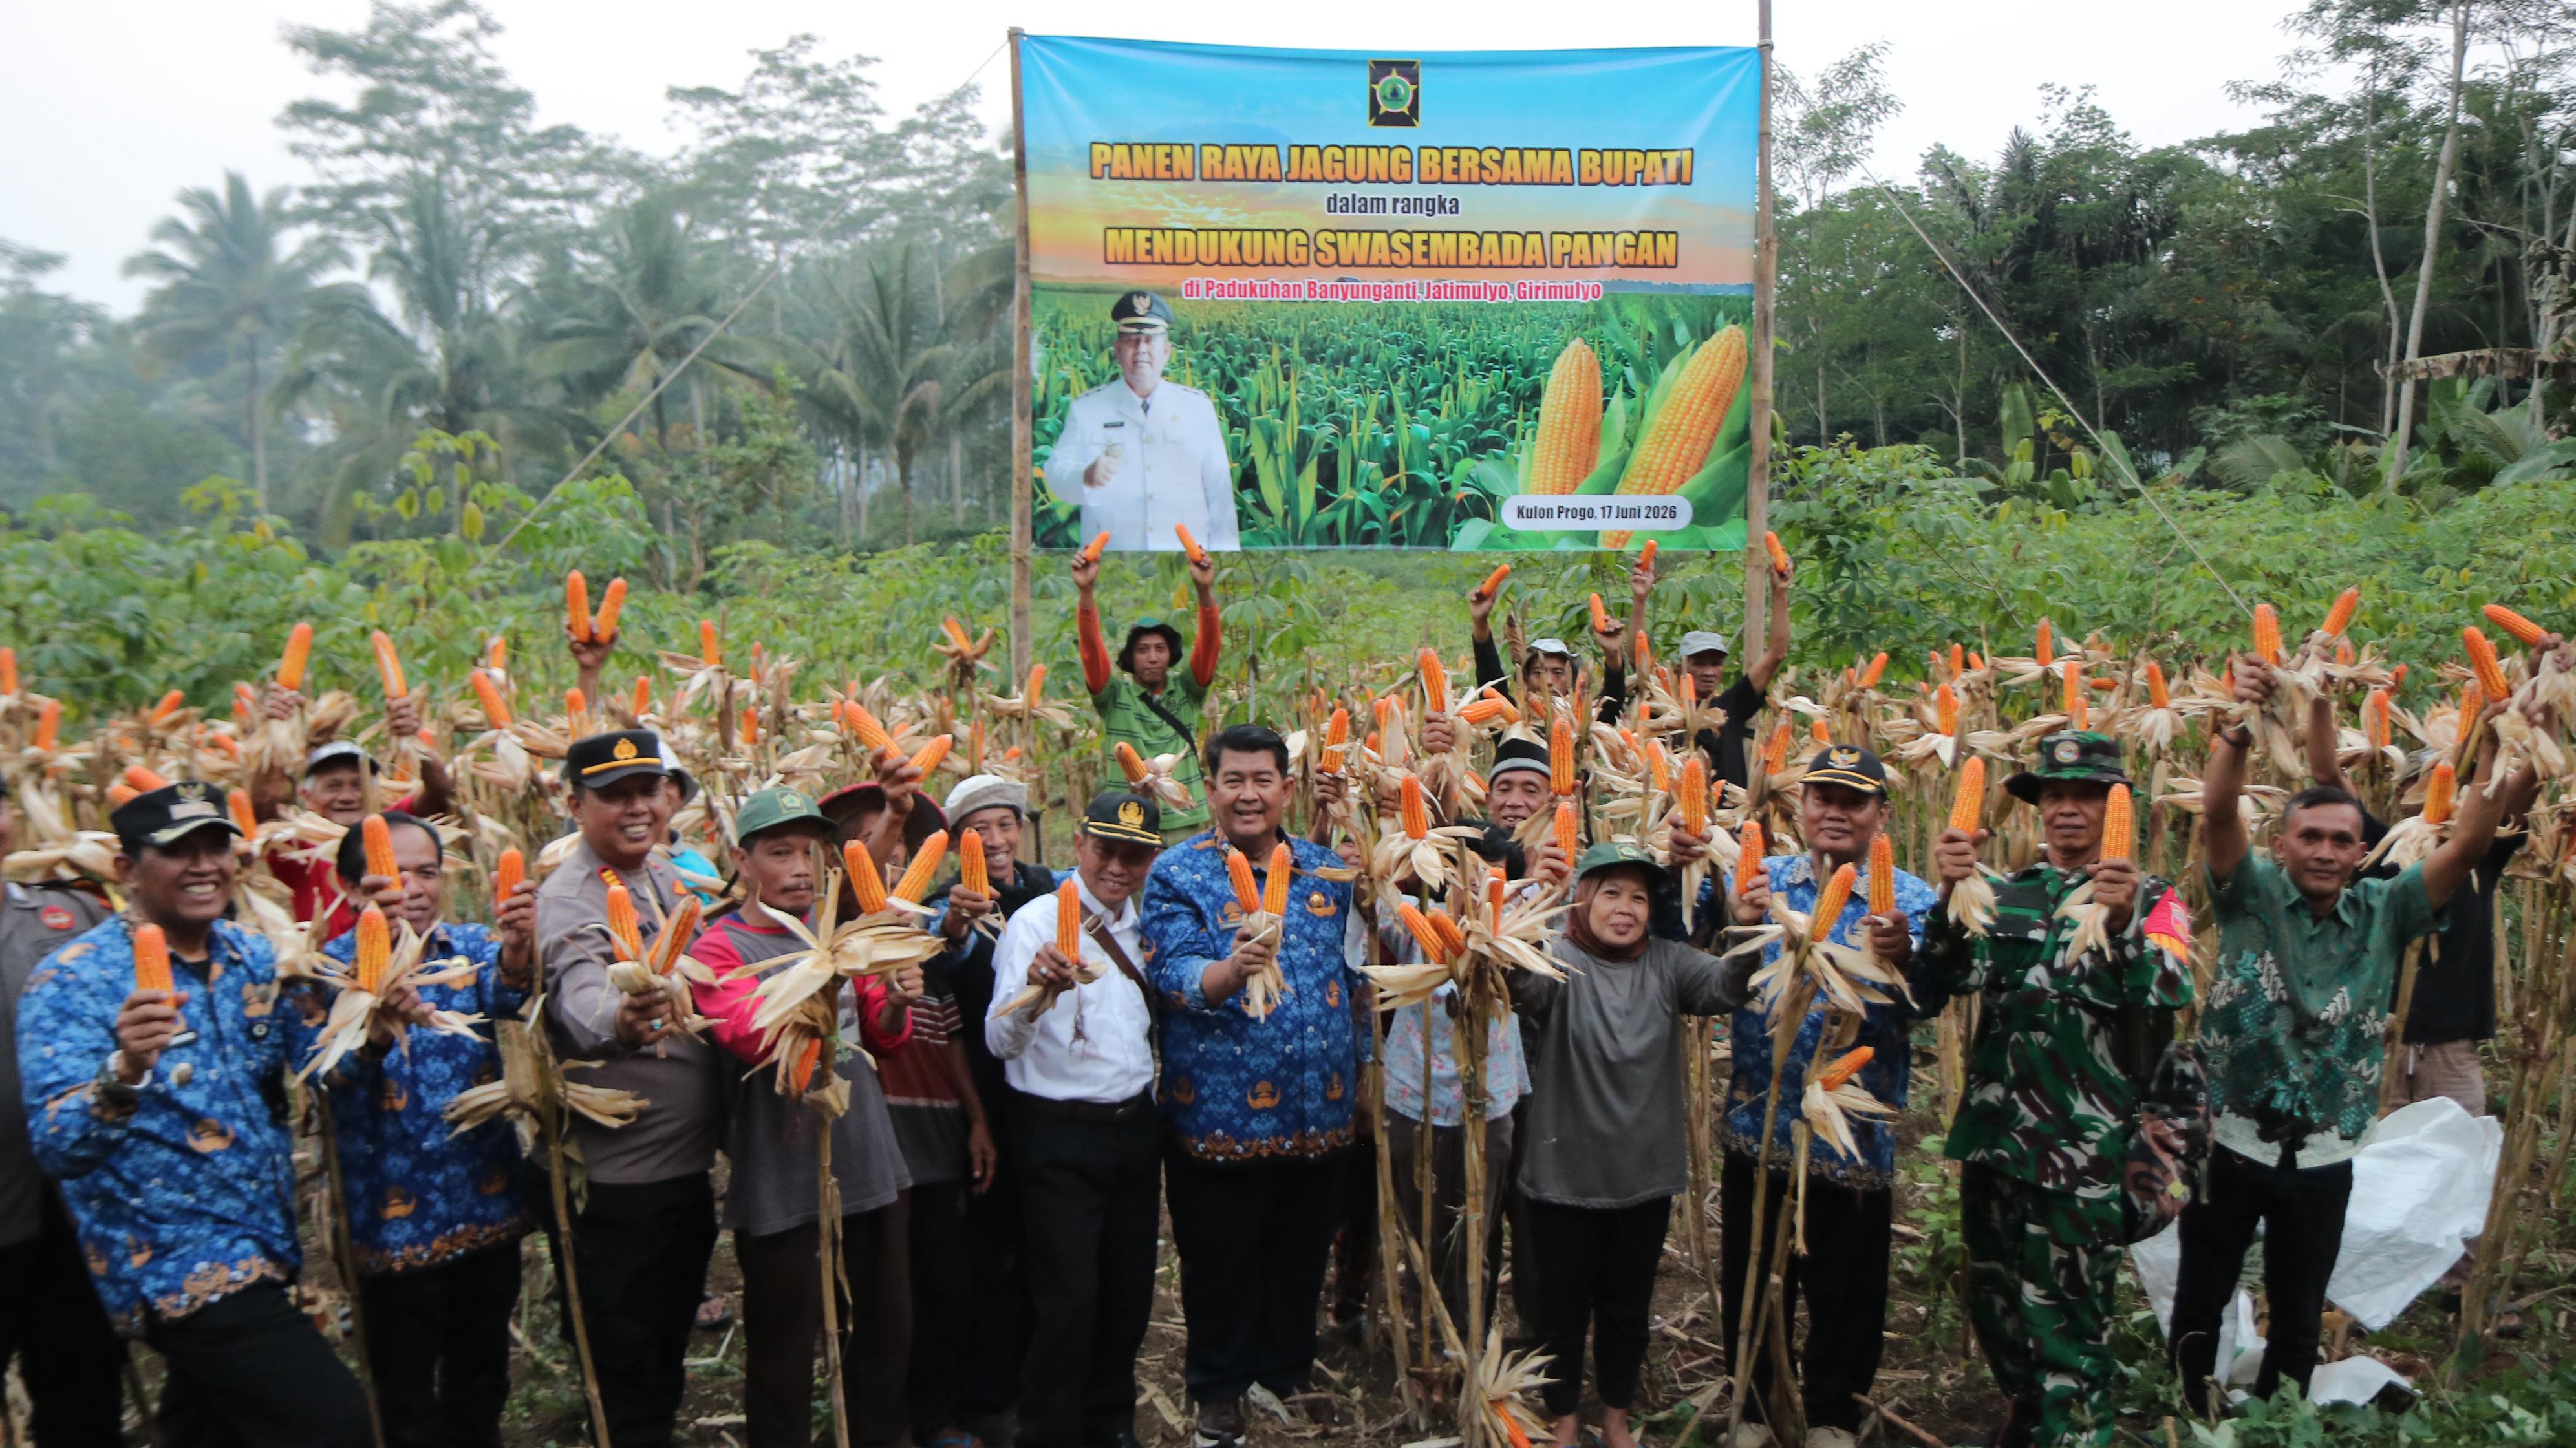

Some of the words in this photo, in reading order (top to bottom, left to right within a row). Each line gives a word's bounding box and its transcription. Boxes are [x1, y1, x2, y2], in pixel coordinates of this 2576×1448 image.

[1090, 142, 1194, 181] PANEN
[1200, 144, 1282, 182] RAYA
[1285, 145, 1413, 183] JAGUNG
[1419, 146, 1574, 185] BERSAMA
[1578, 148, 1693, 186] BUPATI
[1327, 193, 1388, 214] dalam
[1392, 194, 1459, 217] rangka
[1104, 228, 1309, 266] MENDUKUNG
[1315, 229, 1547, 268] SWASEMBADA
[1551, 231, 1678, 268] PANGAN
[1184, 279, 1201, 298] di
[1205, 280, 1302, 299] Padukuhan
[1307, 281, 1422, 301] Banyunganti,
[1424, 281, 1513, 302] Jatimulyo,
[1516, 282, 1602, 301] Girimulyo
[1517, 506, 1553, 519] Kulon
[1558, 506, 1597, 520] Progo,
[1601, 506, 1612, 519] 17
[1616, 506, 1640, 519] Juni
[1644, 506, 1677, 519] 2026
